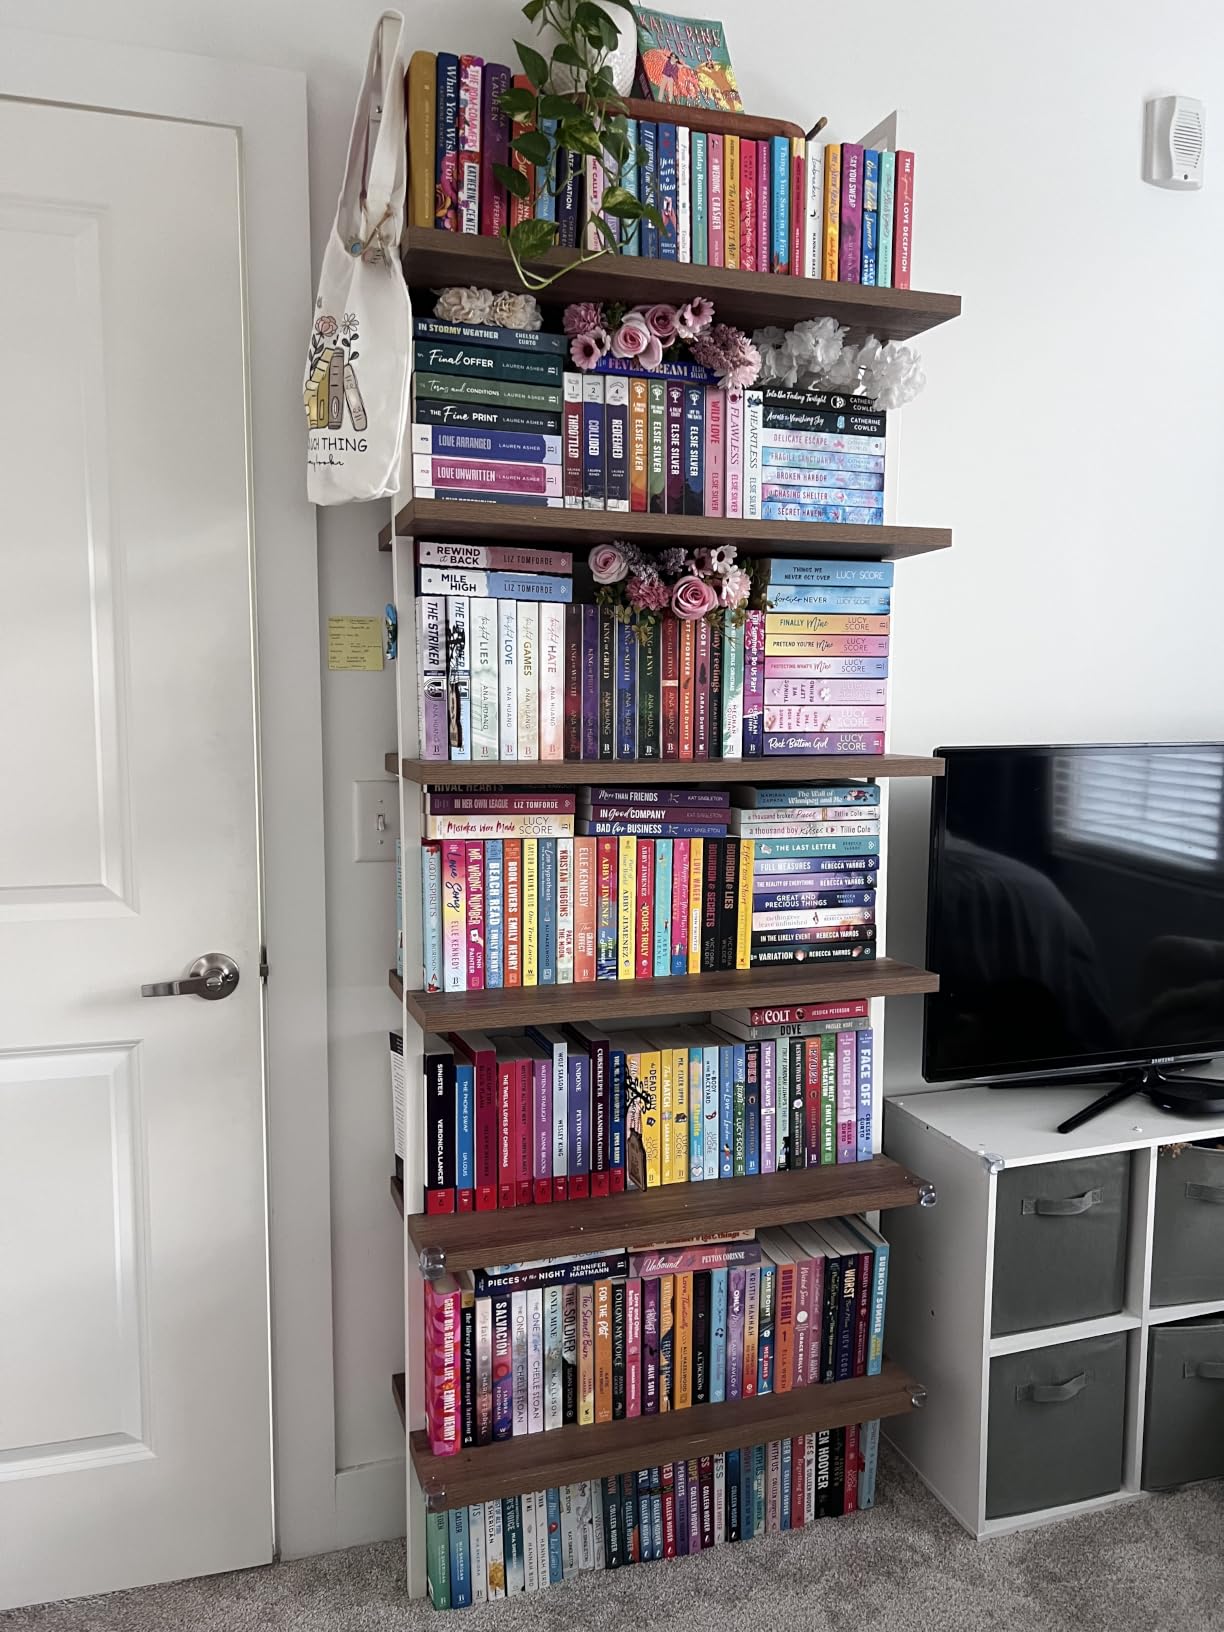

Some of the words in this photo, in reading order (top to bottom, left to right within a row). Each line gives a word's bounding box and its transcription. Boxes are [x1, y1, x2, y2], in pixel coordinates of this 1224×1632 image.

[446, 65, 457, 98] What
[445, 102, 456, 123] You
[445, 127, 457, 158] Wish
[696, 139, 704, 174] Holiday
[848, 155, 858, 168] SAY
[445, 161, 456, 183] For
[848, 169, 857, 183] YOU
[465, 165, 477, 205] KATHERINE
[696, 175, 704, 212] Romance
[901, 228, 909, 272] DECEPTION
[418, 323, 427, 331] IN
[429, 324, 461, 335] STORMY
[463, 328, 499, 340] WEATHER
[429, 349, 464, 366] Final
[463, 356, 494, 368] OFFER
[466, 387, 500, 397] CONDITIONS
[442, 406, 470, 423] Fine
[472, 413, 498, 423] PRINT
[710, 401, 720, 421] WILD
[850, 417, 881, 426] CATHERINE
[568, 414, 579, 459] THROTTLED
[588, 420, 600, 456] COLLIDED
[611, 419, 623, 459] REDEEMED
[635, 419, 643, 442] ELSIE
[690, 426, 699, 449] ELSIE
[710, 422, 720, 444] LOVE
[730, 407, 740, 465] FLAWLESS
[749, 409, 758, 469] HEARTLESS
[854, 424, 877, 433] COWLES
[321, 437, 368, 453] THING
[438, 434, 455, 447] LOVE
[455, 437, 492, 450] ARRANGED
[635, 443, 644, 471] SILVER
[690, 450, 698, 477] SILVER
[437, 466, 454, 479] LOVE
[455, 468, 496, 482] UNWRITTEN
[776, 471, 800, 481] BROKEN
[777, 507, 800, 517] SECRET
[436, 546, 481, 557] REWIND
[450, 555, 480, 566] BACK
[441, 573, 467, 583] MILE
[835, 569, 857, 578] LUCY
[858, 570, 884, 580] SCORE
[450, 583, 477, 592] HIGH
[504, 583, 514, 592] LIZ
[517, 584, 552, 594] TOMFORDE
[427, 602, 438, 617] THE
[779, 618, 804, 627] FINALLY
[428, 622, 440, 666] STRIKER
[750, 626, 759, 655] Summer
[479, 642, 488, 665] LIES
[504, 639, 513, 665] LOVE
[523, 641, 532, 676] GAMES
[547, 645, 557, 673] HATE
[844, 658, 863, 666] LUCY
[841, 664, 866, 672] SCORE
[750, 677, 759, 693] Part
[768, 737, 785, 750] Rock
[787, 737, 811, 750] Bottom
[812, 736, 829, 750] Girl
[836, 741, 867, 751] SCORE
[840, 734, 863, 742] LUCY
[513, 801, 524, 809] LIZ
[526, 801, 558, 809] TOMFORDE
[614, 792, 629, 801] THAN
[629, 791, 658, 802] FRIENDS
[523, 816, 550, 826] LUCY
[600, 809, 608, 818] IN
[608, 806, 630, 821] Good
[630, 810, 666, 819] COMPANY
[519, 825, 553, 835] SCORE
[596, 824, 610, 833] BAD
[611, 822, 627, 835] for
[627, 824, 662, 834] BUSINESS
[468, 847, 482, 863] MR.
[811, 843, 836, 851] LETTER
[507, 861, 517, 882] BOOK
[559, 849, 568, 883] KRISTAN
[468, 864, 481, 892] WRONG
[489, 862, 500, 896] BEACH
[508, 883, 517, 913] LOVERS
[559, 886, 568, 917] HIGGINS
[765, 900, 799, 908] PRECIOUS
[801, 899, 827, 907] THINGS
[468, 894, 481, 925] NUMBER
[489, 899, 500, 925] READ
[640, 905, 649, 932] YOURS
[490, 929, 498, 950] EMILY
[622, 915, 630, 958] JIMENEZ
[640, 933, 649, 957] TRULY
[490, 950, 498, 973] HENRY
[758, 951, 794, 961] VARIATION
[764, 1009, 790, 1024] COLT
[780, 1024, 802, 1036] DOVE
[860, 1048, 871, 1080] FACE
[860, 1083, 871, 1106] OFF
[570, 1267, 609, 1278] HARTMANN
[572, 1262, 607, 1272] JENNIFER
[643, 1256, 684, 1273] Unbound
[487, 1276, 519, 1288] PIECES
[539, 1269, 566, 1280] NIGHT
[748, 1272, 757, 1301] KRISTIN
[844, 1269, 856, 1299] WORST
[877, 1256, 887, 1296] BURNOUT
[443, 1298, 454, 1318] GREAT
[874, 1297, 884, 1333] SUMMER
[443, 1318, 454, 1331] BIG
[748, 1304, 756, 1336] HANNAH
[443, 1332, 454, 1366] BEAUTIFUL
[443, 1366, 454, 1381] LIFE
[443, 1389, 455, 1413] EMILY
[443, 1415, 455, 1441] HENRY
[771, 1461, 779, 1473] US
[818, 1450, 829, 1489] HOOVER
[487, 1505, 495, 1545] SHERIDAN
